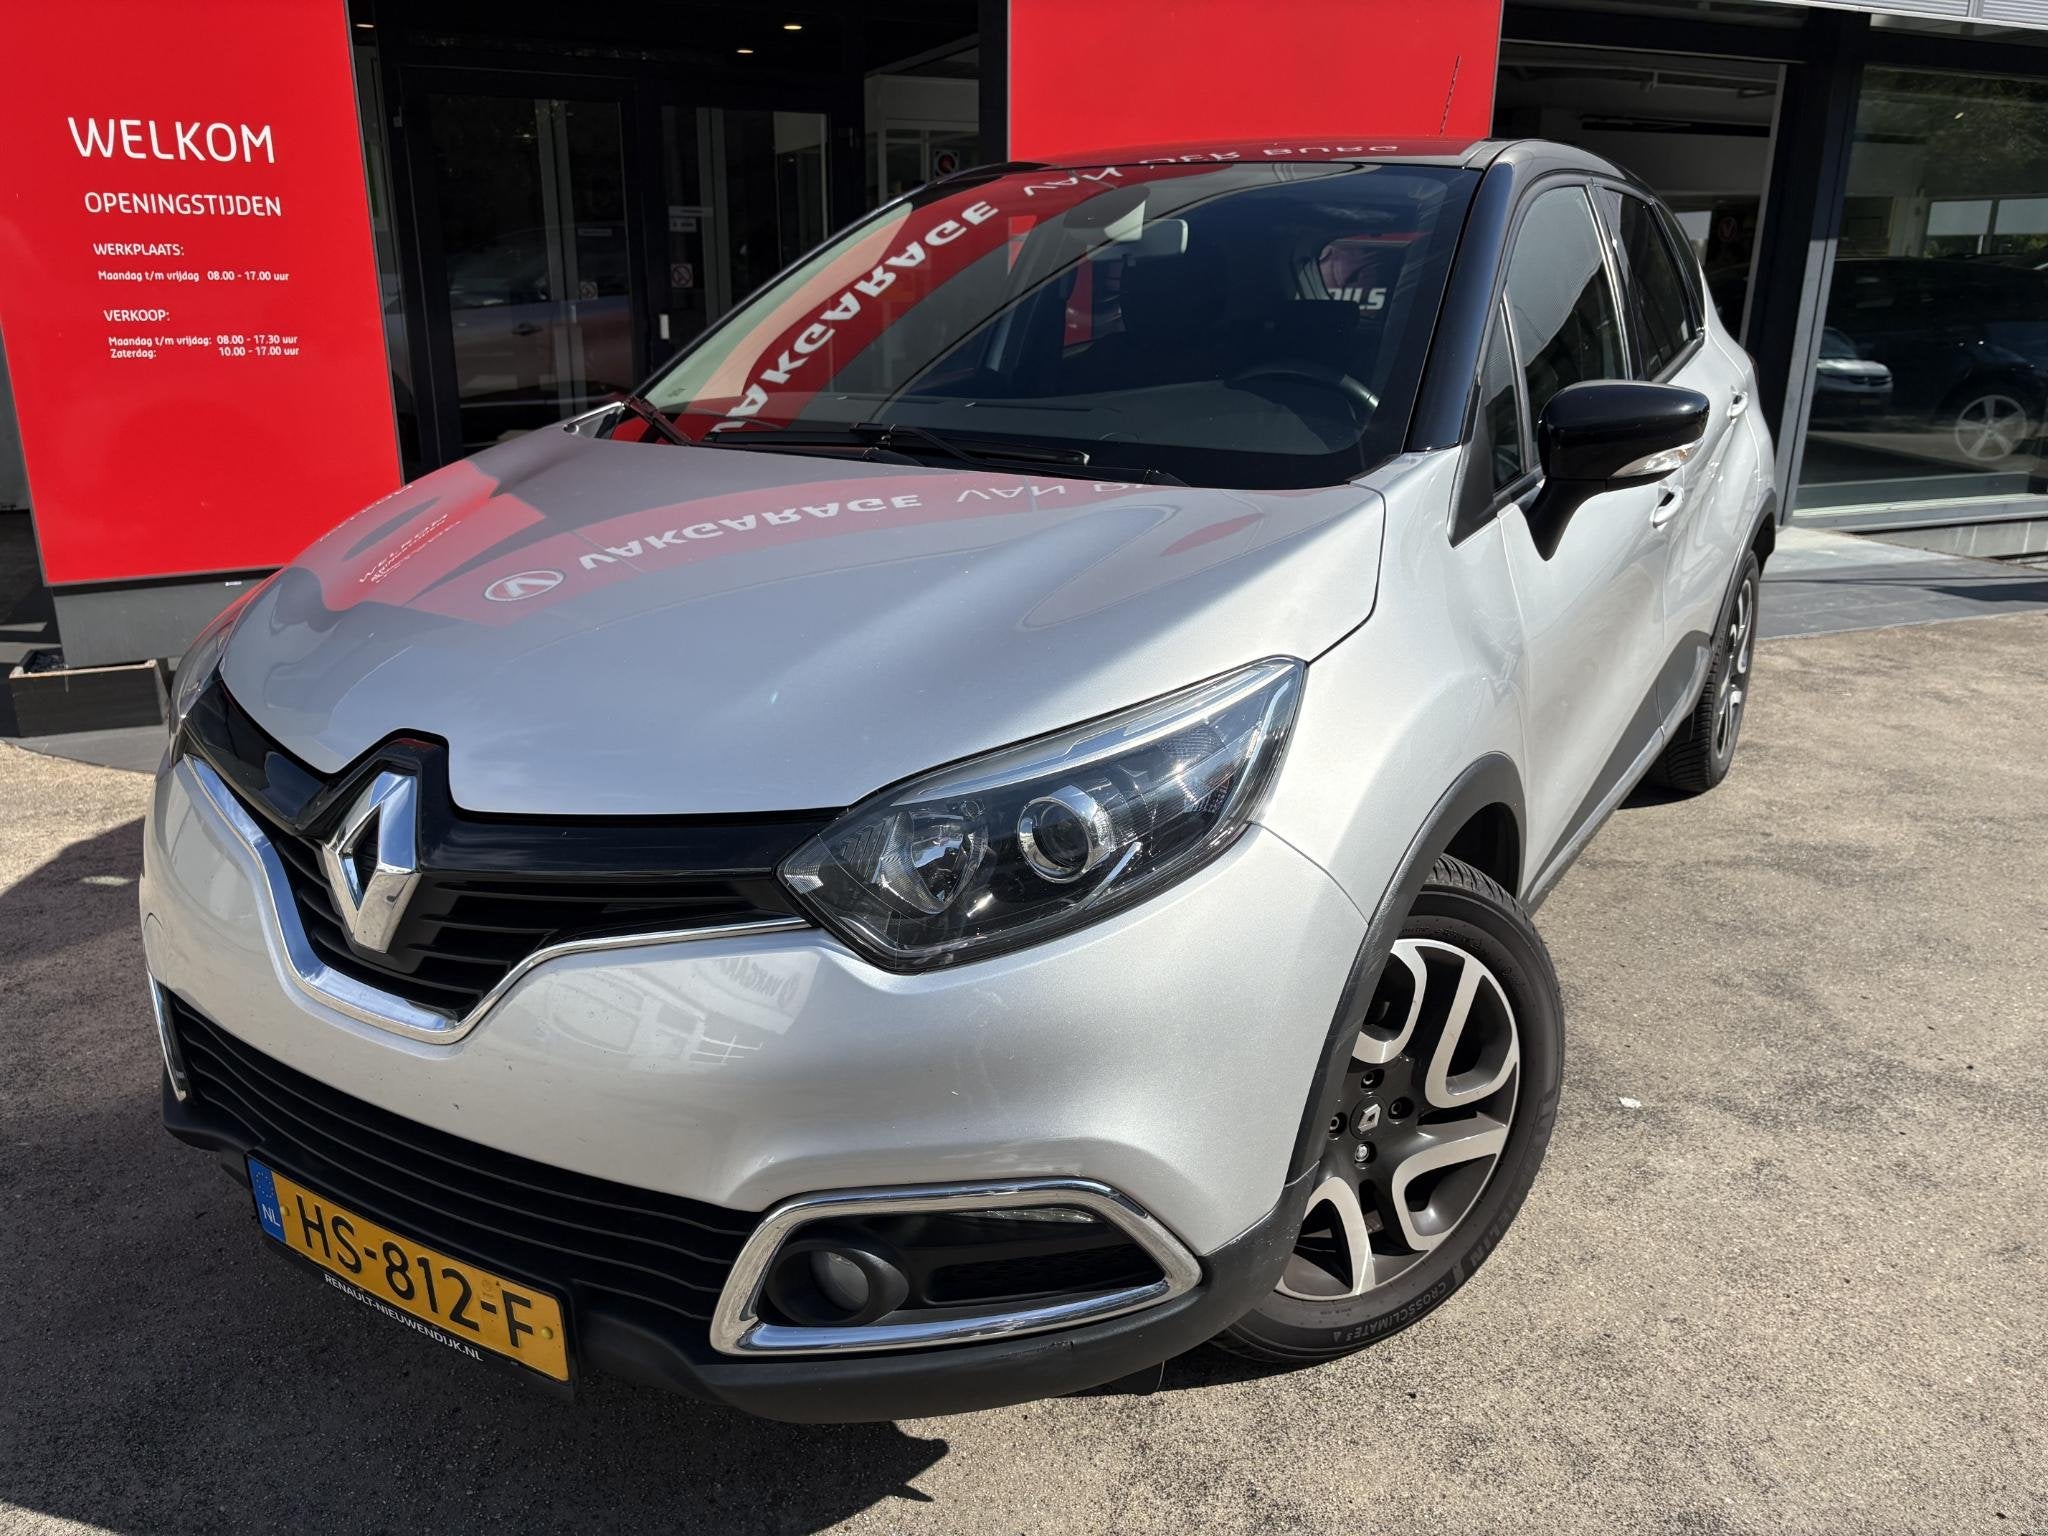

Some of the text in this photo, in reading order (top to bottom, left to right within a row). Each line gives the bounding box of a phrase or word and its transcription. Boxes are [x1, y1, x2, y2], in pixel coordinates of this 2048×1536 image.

[67, 116, 275, 164] WELKOM
[84, 191, 282, 217] OPENINGSTIJDEN
[93, 242, 185, 256] WERKPLAATS:
[98, 270, 143, 283] Maandag
[144, 270, 165, 281] t/m
[166, 270, 200, 283] vrijdag
[207, 270, 235, 281] 08.00
[244, 270, 272, 281] 17.00
[273, 273, 290, 281] uur
[103, 309, 171, 322] VERKOOP:
[108, 336, 153, 347] Maandag
[154, 336, 175, 346] t/m
[176, 336, 213, 347] vrijdag:
[216, 334, 245, 345] 08.00
[253, 334, 281, 345] 17.30
[282, 336, 299, 344] uur
[109, 348, 157, 359] Zaterdag:
[218, 346, 246, 357] 10.00
[254, 346, 282, 357] 17.00
[283, 347, 300, 356] uur
[261, 1202, 281, 1227] NL
[296, 1194, 534, 1348] HS-812-F
[324, 1273, 484, 1362] RENAULT-NIEUWENDIJK.NL
